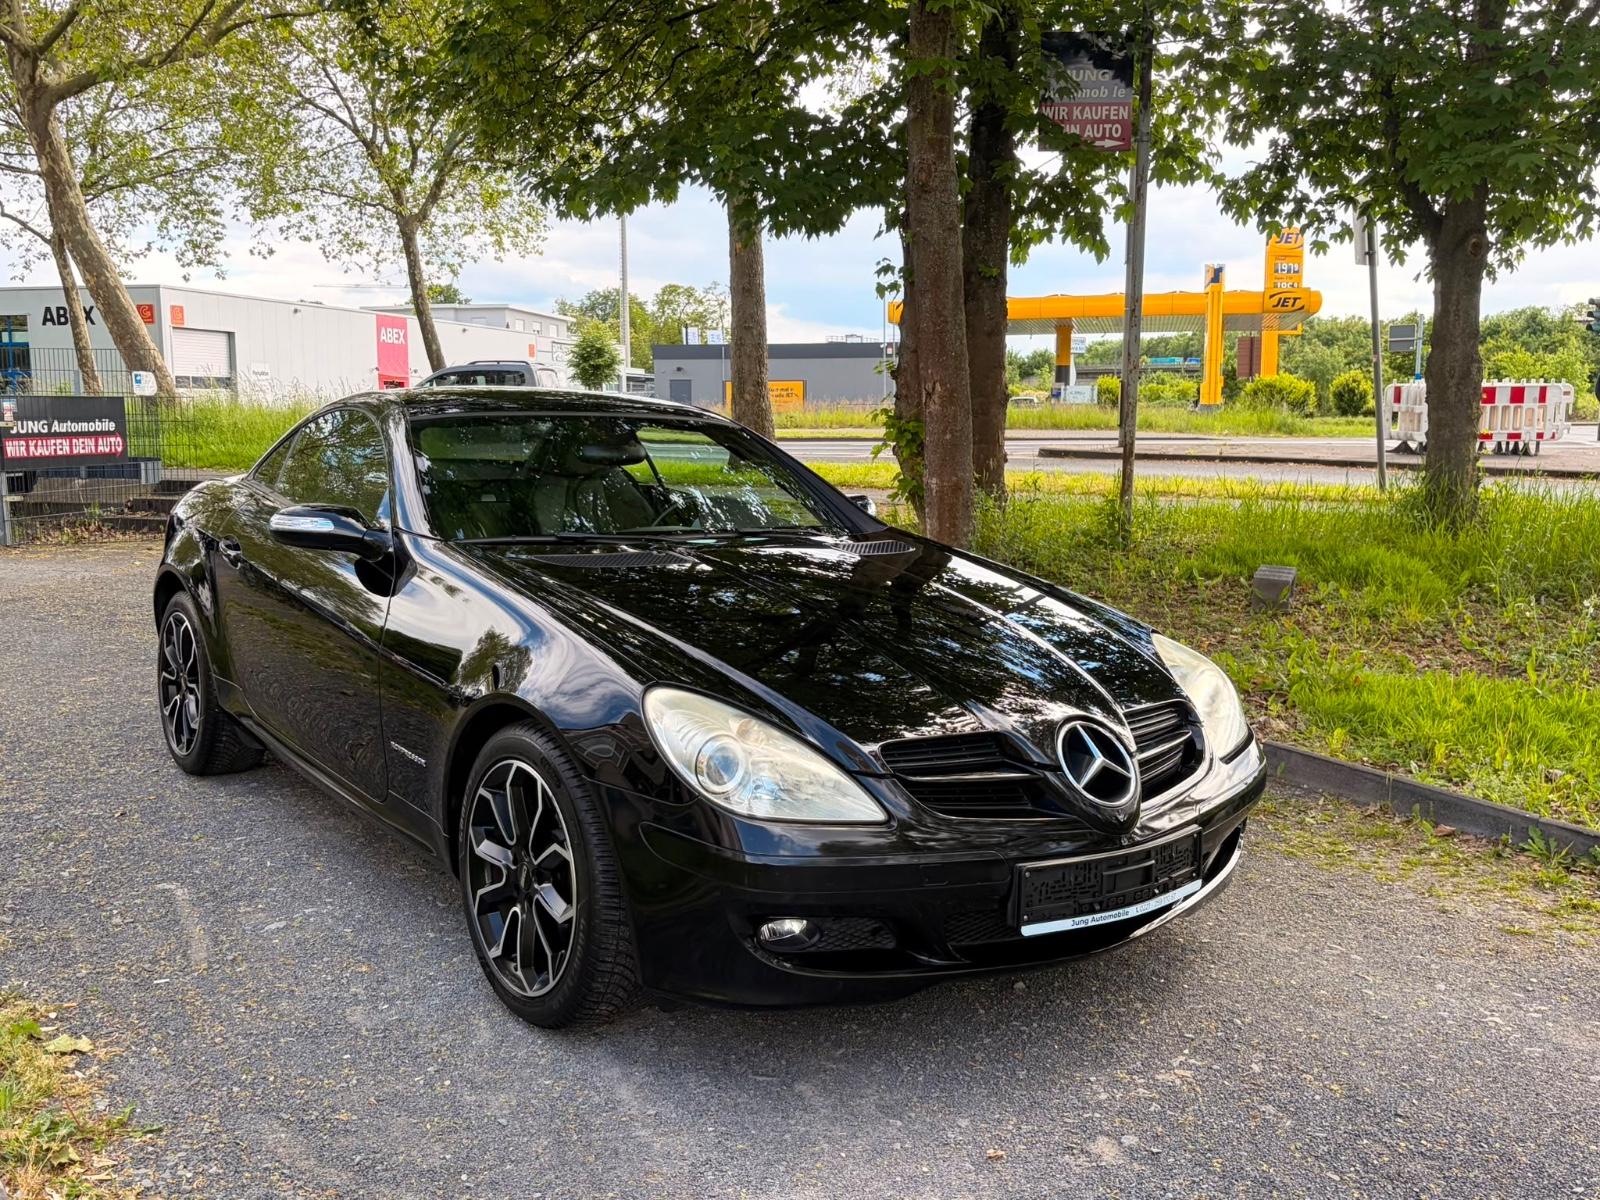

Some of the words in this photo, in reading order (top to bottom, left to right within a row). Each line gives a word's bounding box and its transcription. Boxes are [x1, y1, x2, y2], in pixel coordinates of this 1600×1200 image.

[1072, 106, 1129, 120] KAUFEN
[1084, 123, 1122, 138] AUTO
[1272, 297, 1301, 308] JET
[42, 305, 96, 326] ABX
[380, 327, 405, 344] ABEX
[51, 418, 116, 433] Automobile
[6, 439, 27, 457] WIR
[29, 439, 70, 457] KAUFEN
[72, 437, 96, 455] DEIN
[98, 436, 122, 453] AUTO
[1071, 918, 1089, 927] Jung
[1090, 910, 1130, 923] Automobile
